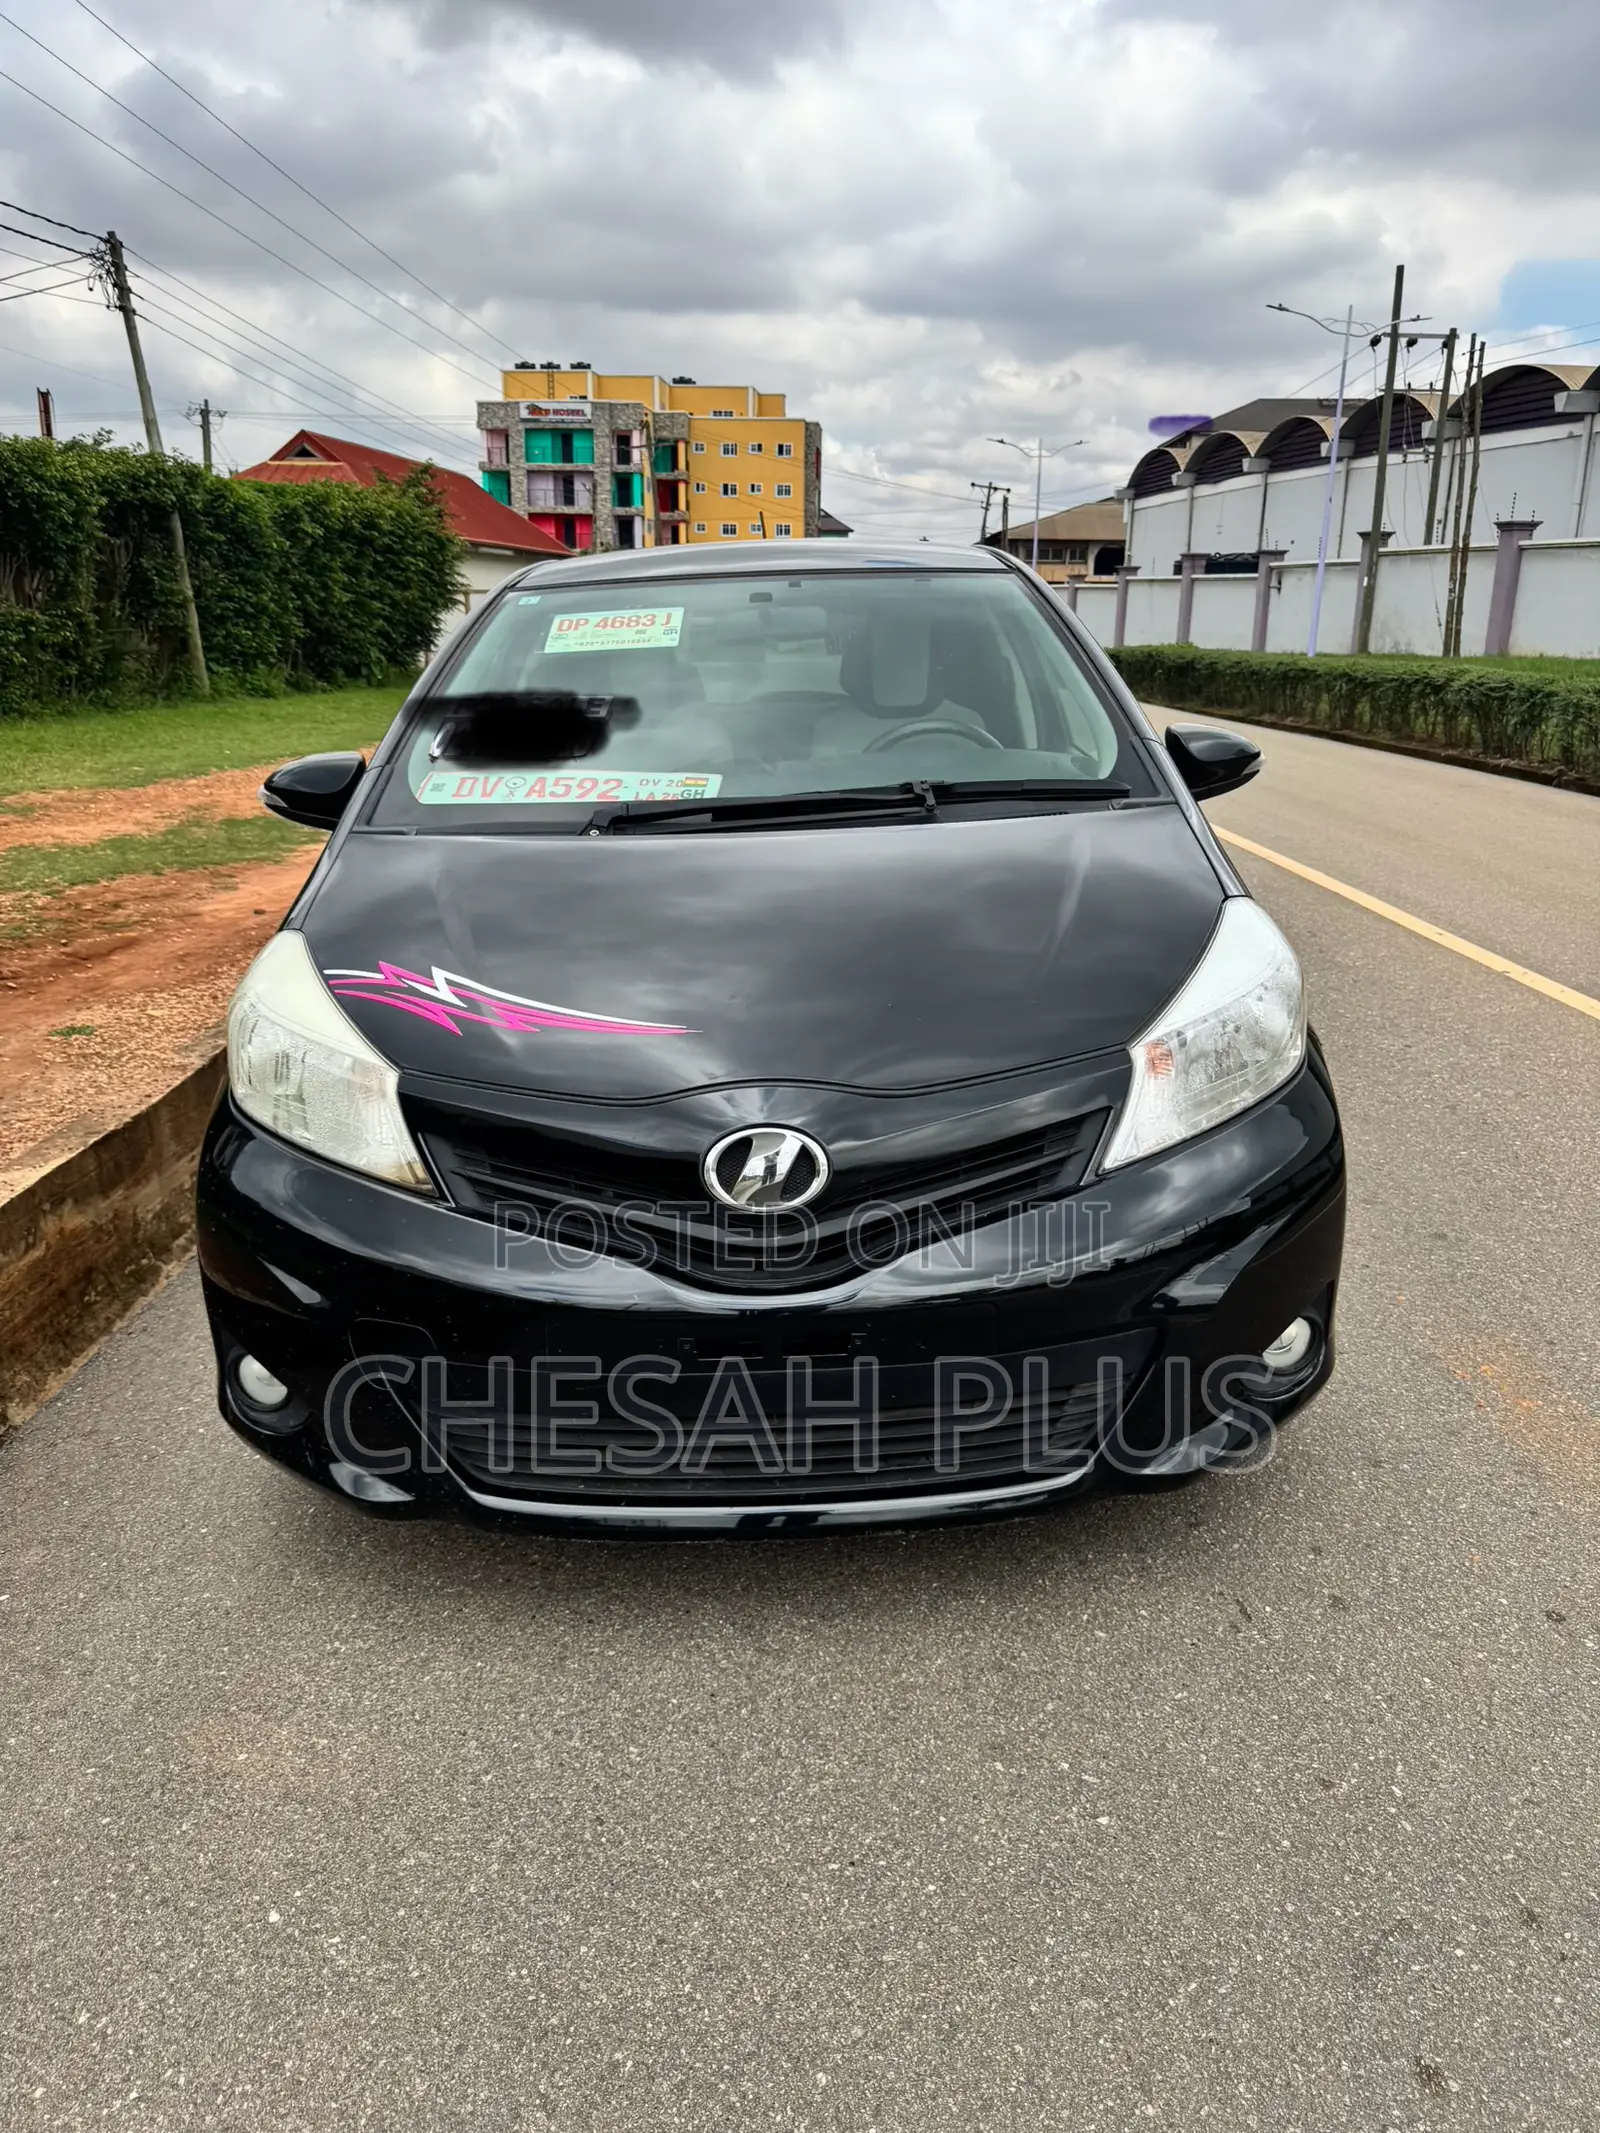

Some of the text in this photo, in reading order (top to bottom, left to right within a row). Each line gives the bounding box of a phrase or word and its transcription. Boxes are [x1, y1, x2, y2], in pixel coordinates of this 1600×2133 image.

[594, 614, 656, 630] 4683
[523, 776, 624, 801] A592
[639, 778, 661, 787] DV
[680, 788, 706, 800] GH
